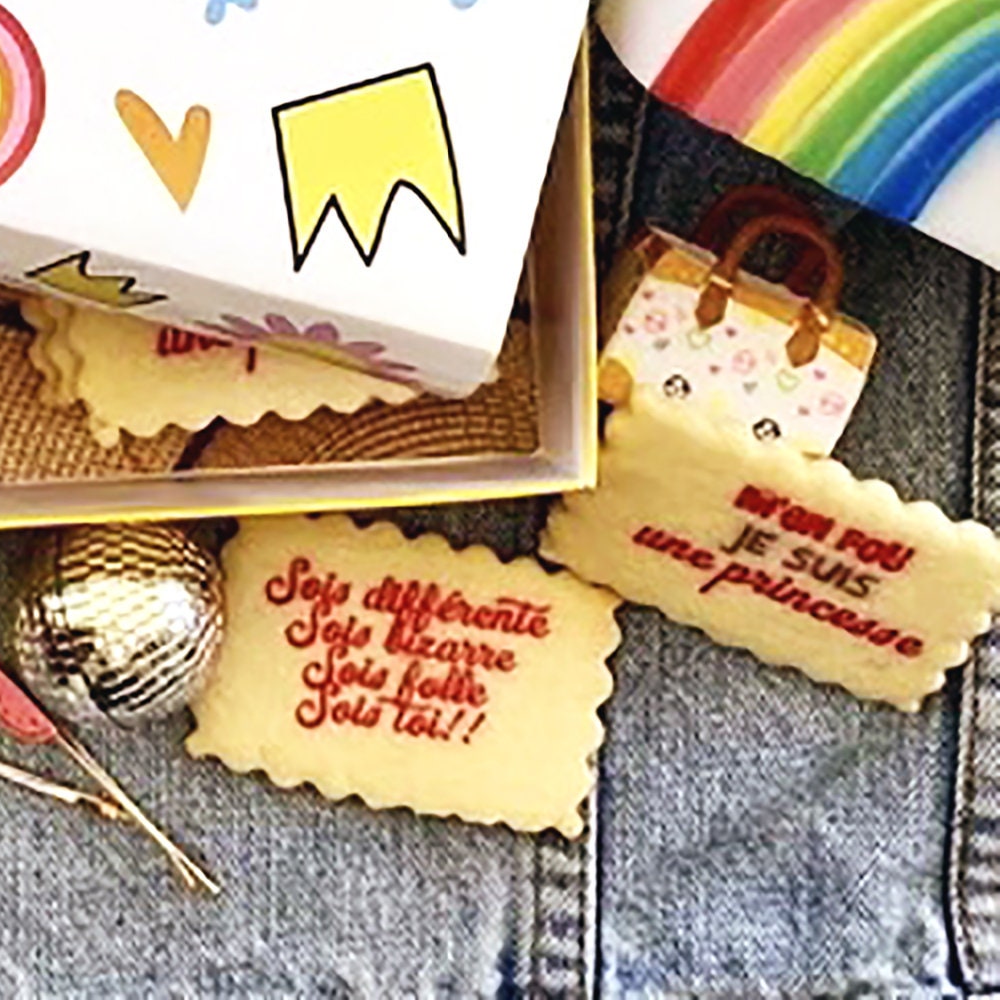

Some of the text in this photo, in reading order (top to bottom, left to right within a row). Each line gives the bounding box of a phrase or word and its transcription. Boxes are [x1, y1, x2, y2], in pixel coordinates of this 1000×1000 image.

[265, 557, 350, 605] Sois
[720, 523, 880, 599] JE SUIS
[632, 526, 924, 658] une princesse
[285, 600, 372, 648] Sois
[302, 645, 389, 690] Sois
[295, 682, 382, 729] Sois
